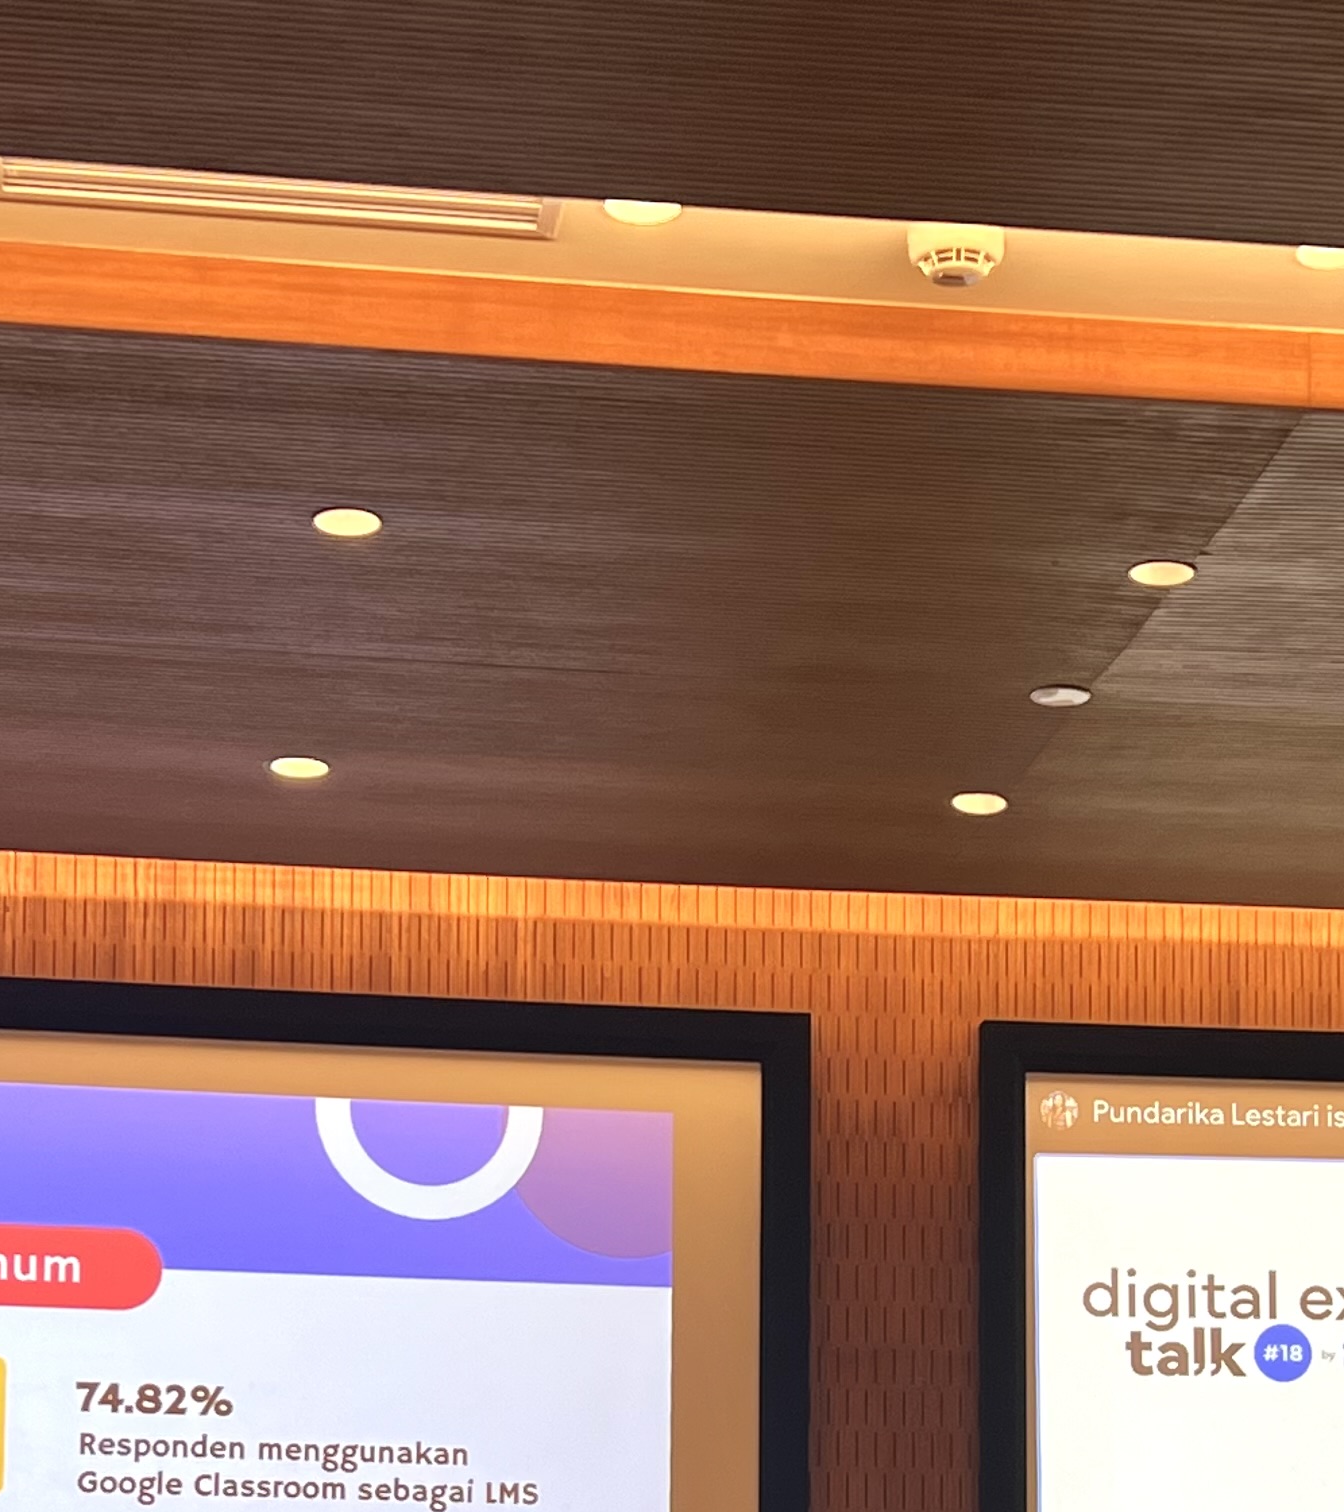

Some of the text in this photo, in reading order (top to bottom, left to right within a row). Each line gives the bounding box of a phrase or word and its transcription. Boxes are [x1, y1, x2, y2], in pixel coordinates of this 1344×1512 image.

[1094, 1100, 1224, 1125] Pundarika
[1232, 1103, 1319, 1126] Lestari
[1083, 1268, 1277, 1330] digital
[1125, 1327, 1336, 1377] talk #18 by
[76, 1382, 233, 1416] 74.82%
[80, 1433, 467, 1473] Responden menggunakan
[78, 1471, 538, 1512] Google Classroom sebagai LMS
